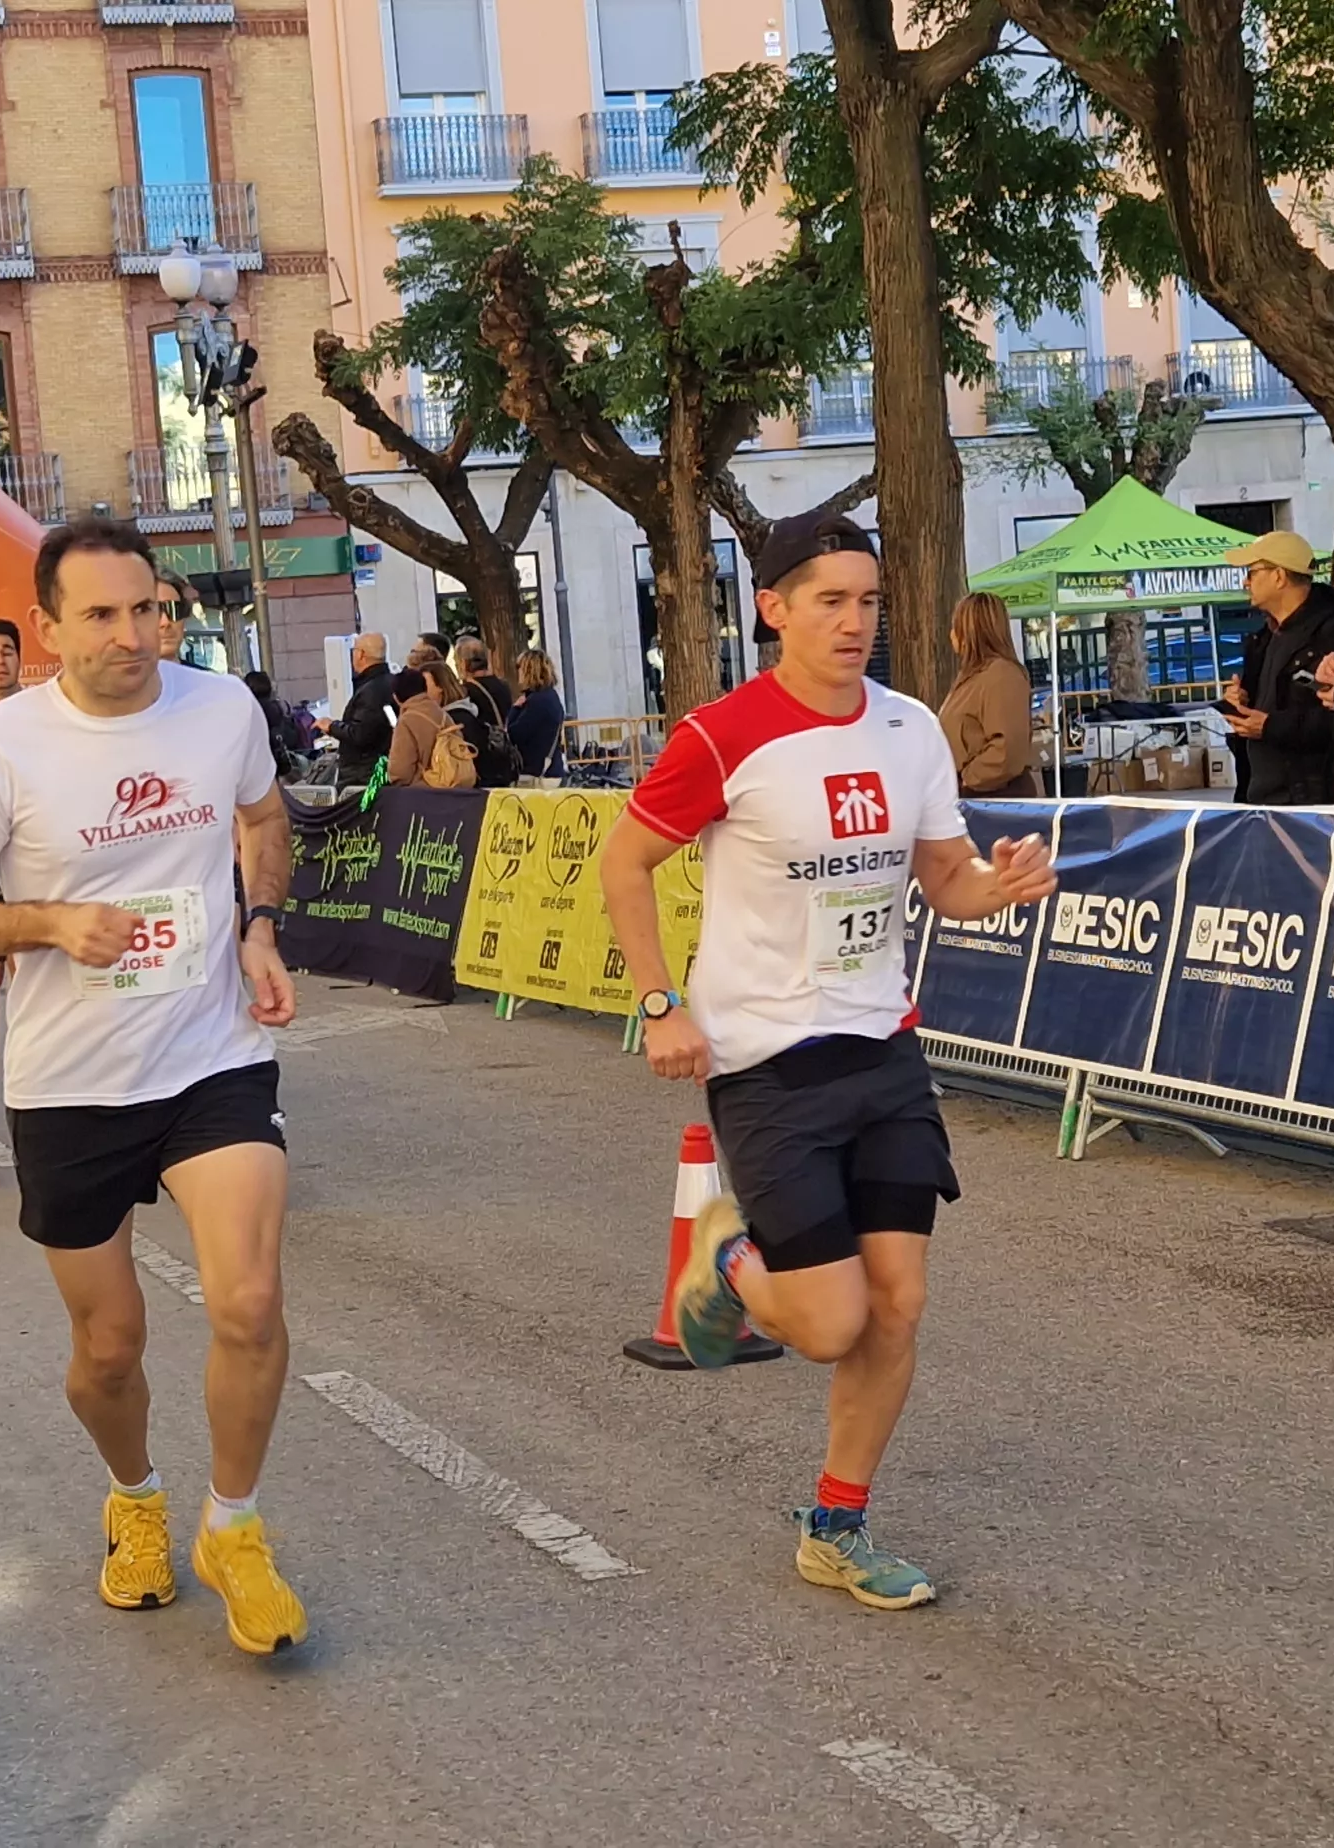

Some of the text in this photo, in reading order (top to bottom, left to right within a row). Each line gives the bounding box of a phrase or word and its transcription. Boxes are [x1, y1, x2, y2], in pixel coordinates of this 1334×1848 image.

[1239, 486, 1248, 500] 2
[1137, 536, 1229, 549] FARTLECK
[1144, 567, 1249, 596] AVITUALLAMIEN
[78, 804, 218, 848] VILLAMAYOR
[838, 903, 895, 941] 137
[1076, 893, 1161, 955] ESIC
[1214, 907, 1304, 972] ESIC
[113, 972, 141, 990] 8K
